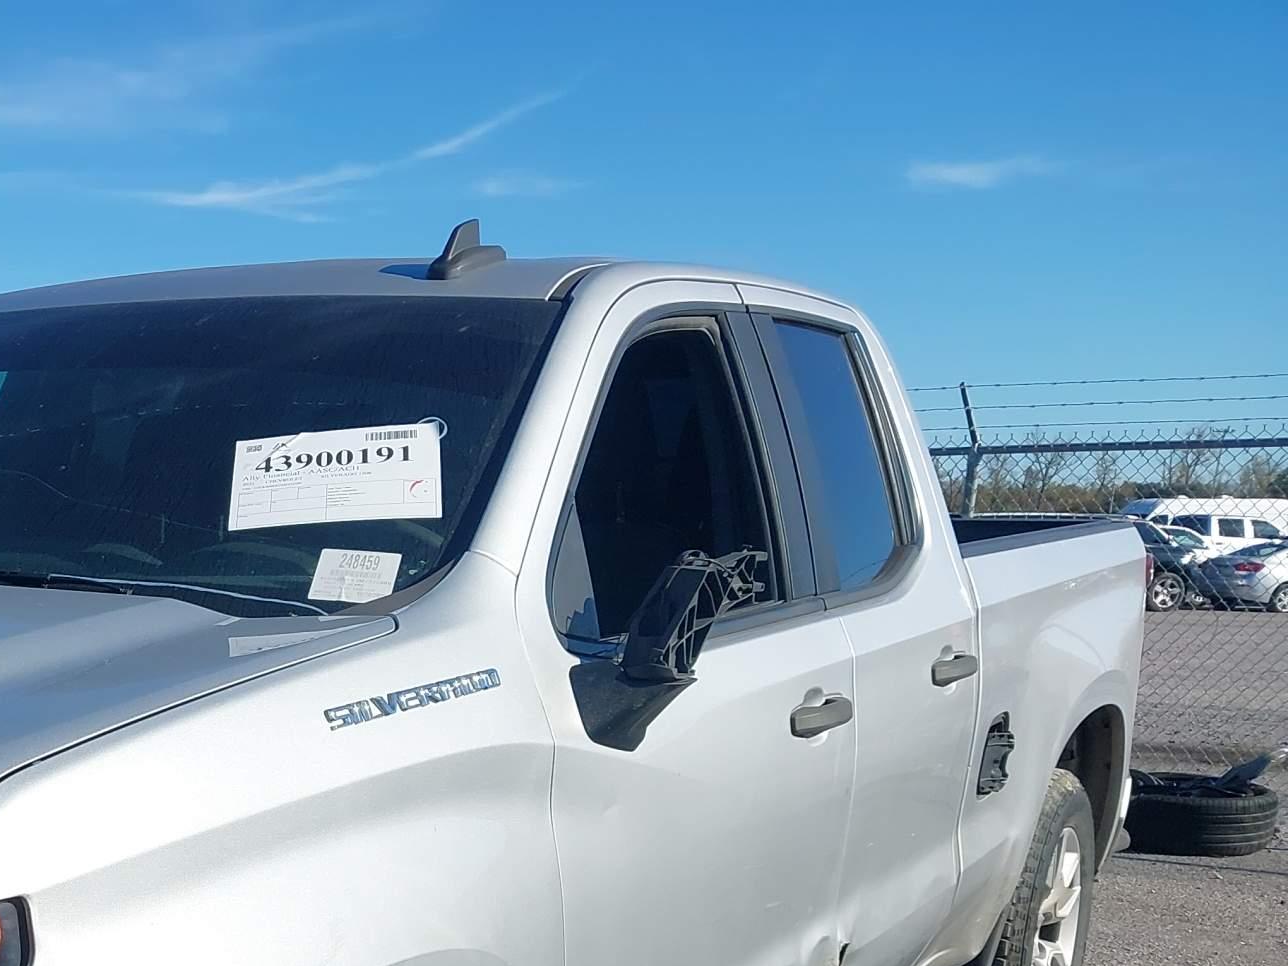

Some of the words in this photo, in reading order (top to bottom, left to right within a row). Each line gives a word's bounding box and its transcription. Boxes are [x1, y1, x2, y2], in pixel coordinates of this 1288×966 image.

[255, 445, 414, 473] 43900191
[339, 553, 381, 570] 248459
[324, 668, 502, 731] SILVERADO
